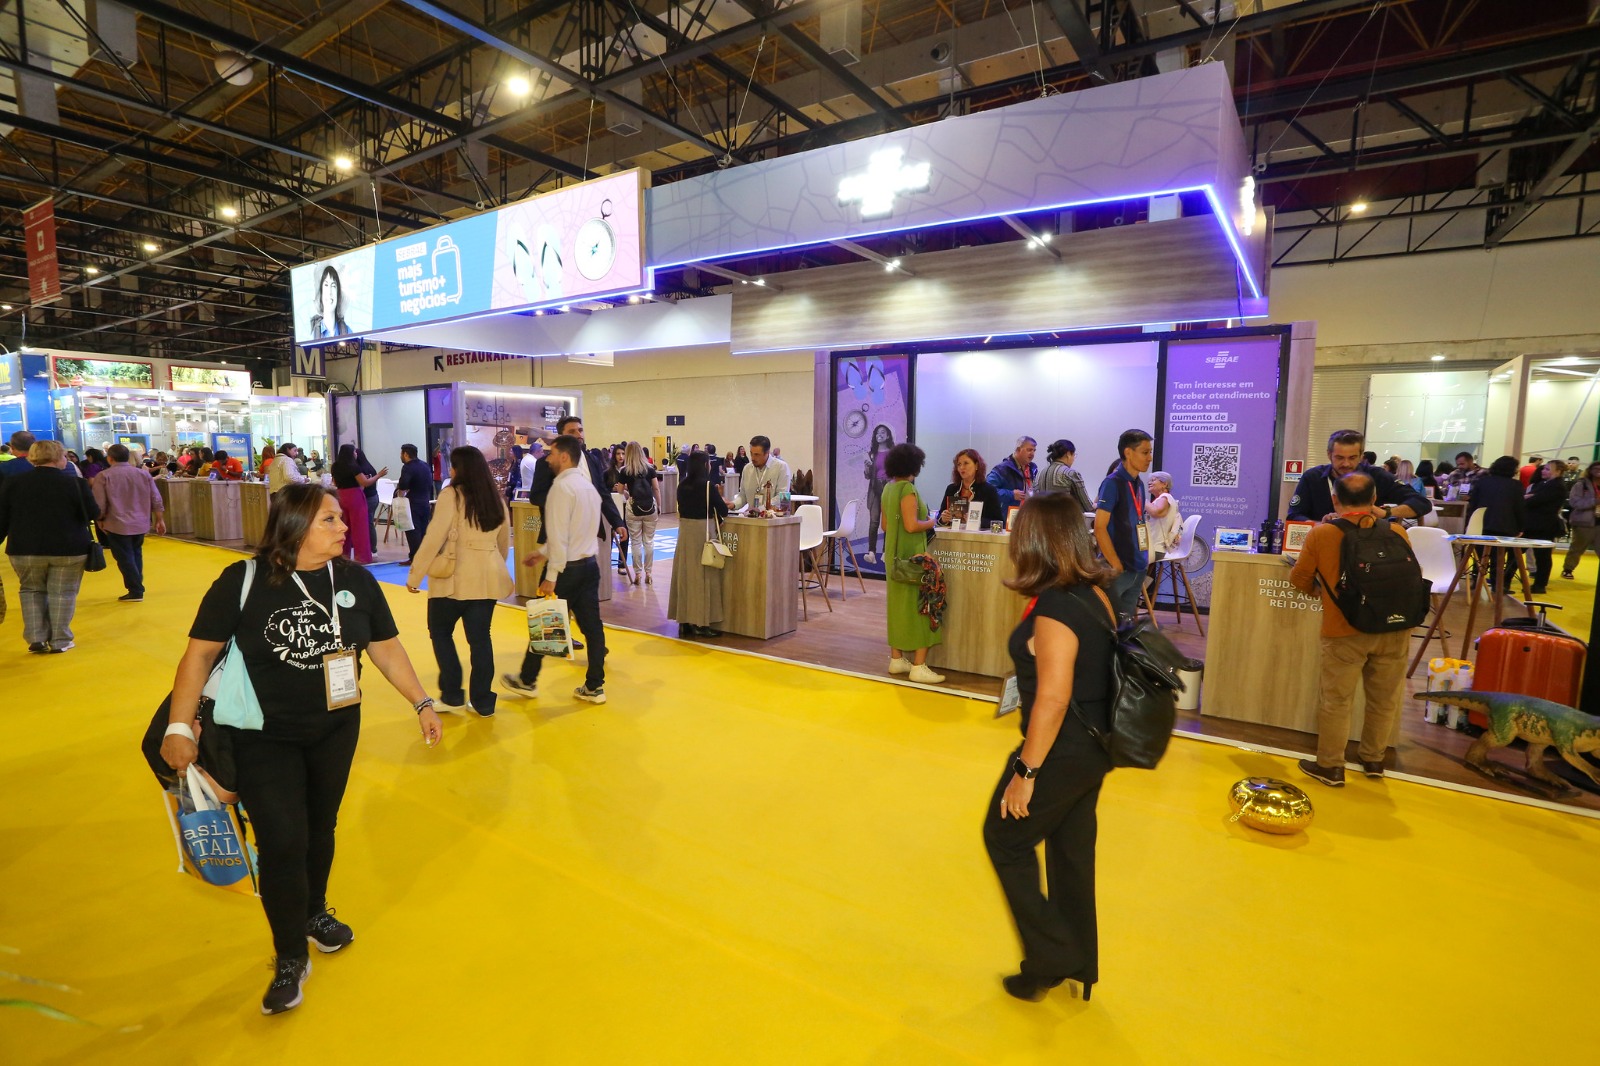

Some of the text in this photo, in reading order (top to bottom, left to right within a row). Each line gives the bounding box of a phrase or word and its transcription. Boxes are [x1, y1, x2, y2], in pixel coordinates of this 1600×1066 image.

[398, 260, 422, 281] mais
[400, 292, 447, 316] negócios
[296, 346, 321, 376] M
[1205, 356, 1240, 364] SEBRAE
[1194, 380, 1237, 388] interesse
[1172, 402, 1204, 410] focado
[1171, 424, 1234, 432] faturamento?
[724, 541, 737, 552] RÉ
[1260, 588, 1294, 598] PELAS
[1270, 599, 1286, 608] REI
[1290, 601, 1306, 610] DO
[292, 608, 316, 616] ando
[286, 659, 308, 670] estoy
[187, 838, 239, 857] TAL
[196, 857, 242, 868] PTIVOS
